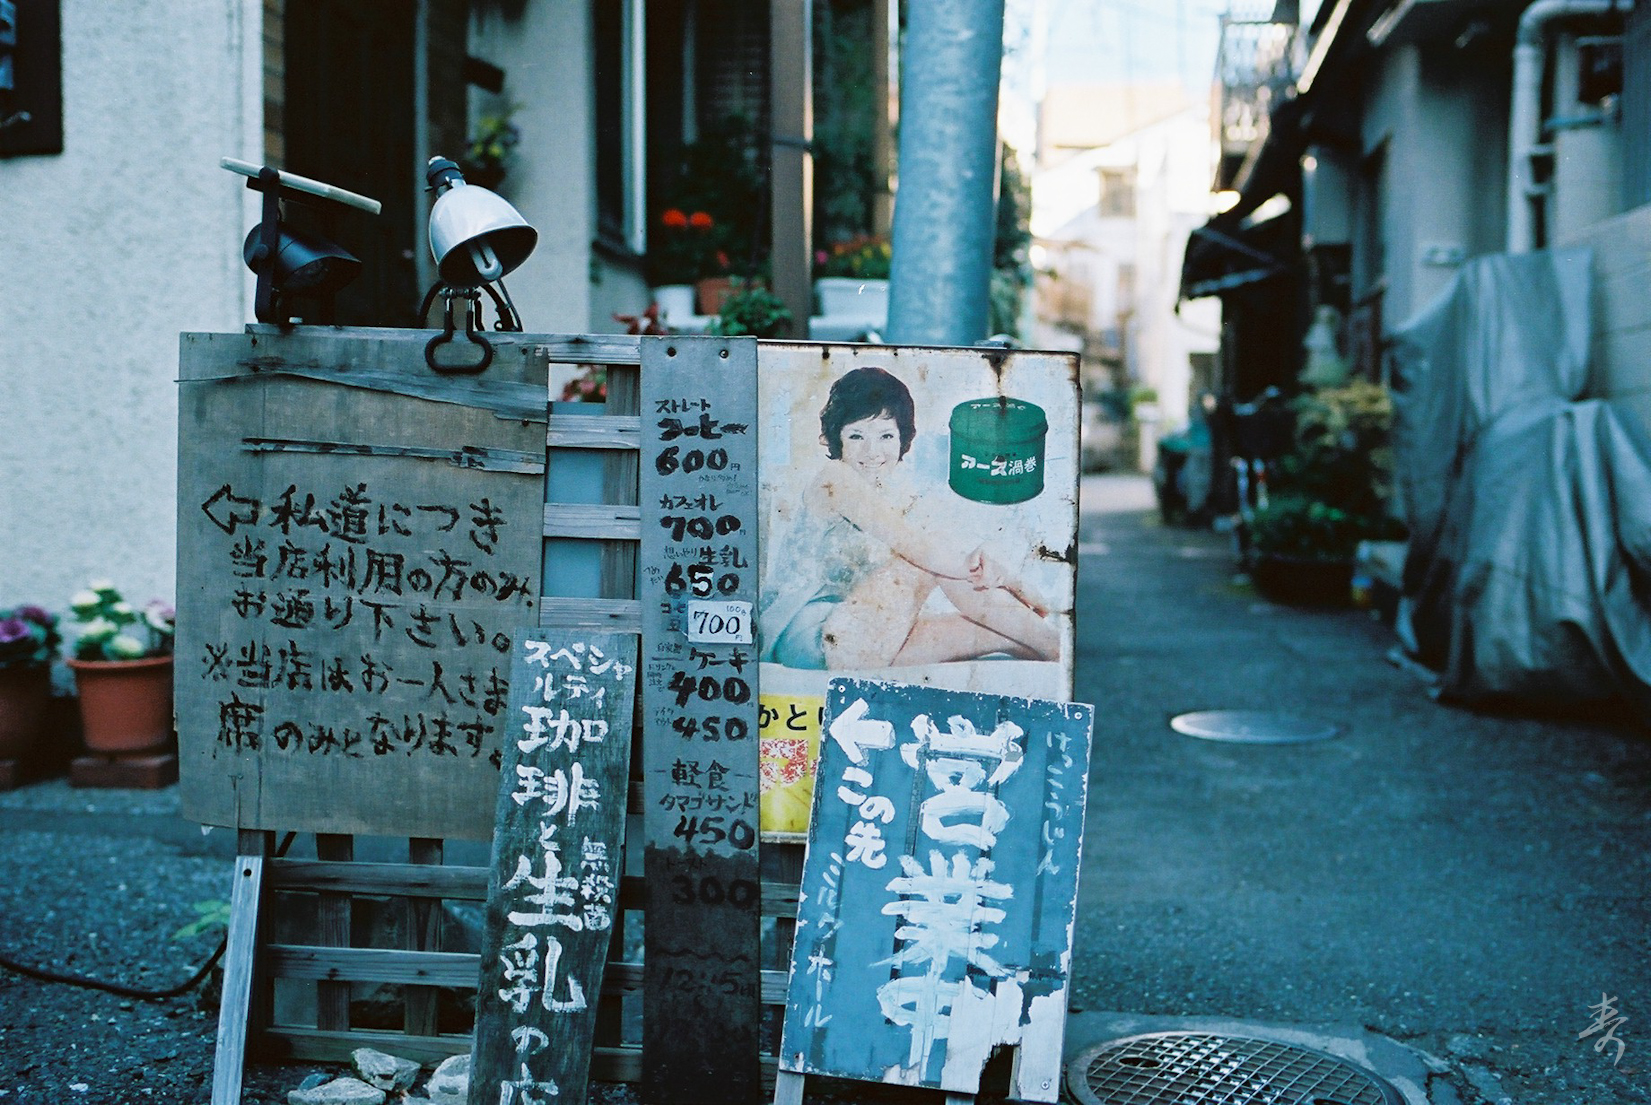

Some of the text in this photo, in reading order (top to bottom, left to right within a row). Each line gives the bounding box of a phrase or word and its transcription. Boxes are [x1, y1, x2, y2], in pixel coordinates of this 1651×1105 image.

[655, 398, 711, 414] ストレート
[961, 454, 1036, 476] アース渦巻
[660, 493, 723, 511] カフェオレ
[269, 482, 506, 554] 私道につき
[698, 545, 749, 568] 生乳
[232, 587, 510, 651] お通り下さい。
[524, 640, 632, 681] スペシャ
[689, 647, 749, 674] ケーキ
[759, 704, 824, 731] かと
[671, 758, 730, 792] 軽食
[659, 791, 757, 815] タマゴサンド
[837, 766, 896, 869] この先
[870, 713, 1024, 1082] 営業中
[803, 852, 845, 1028] ミルクホール
